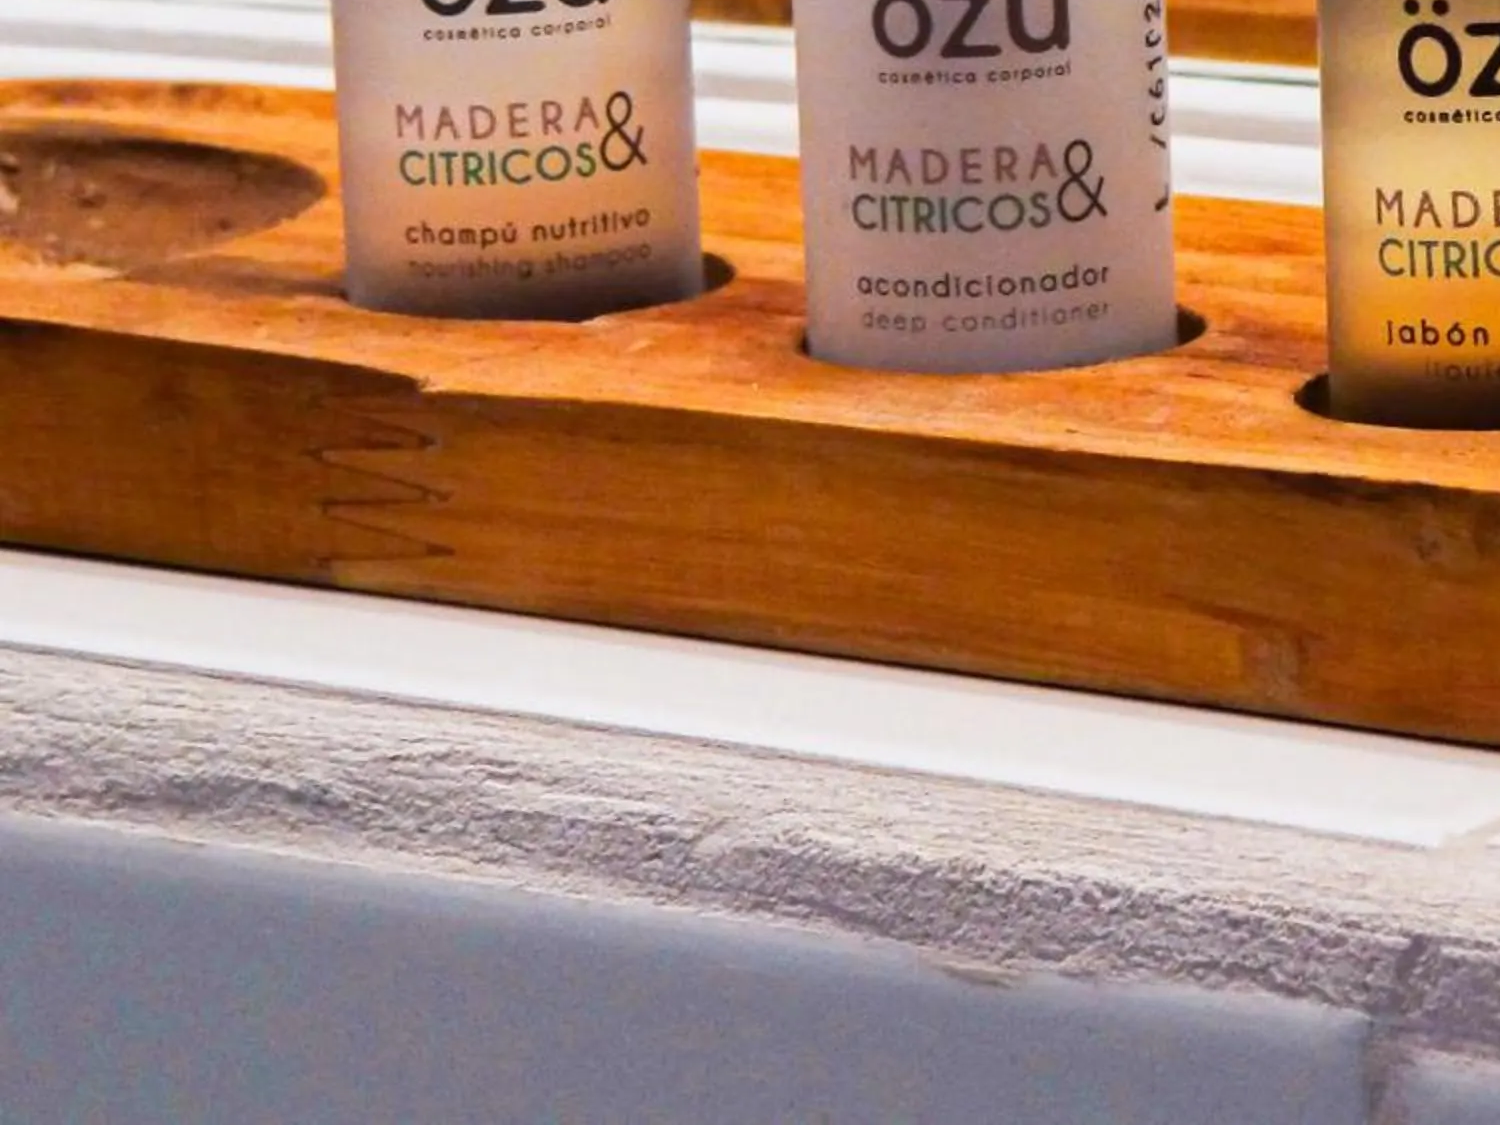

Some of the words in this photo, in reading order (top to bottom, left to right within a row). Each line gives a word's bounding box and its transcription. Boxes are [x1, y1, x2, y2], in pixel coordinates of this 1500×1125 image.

[423, 25, 521, 42] cosmética
[530, 13, 612, 38] corporal
[878, 69, 978, 85] cosmética
[987, 61, 1072, 83] corporal
[395, 96, 600, 142] MADERA
[600, 90, 648, 173] &
[399, 142, 597, 186] CITRICOS
[848, 142, 1058, 185] MADERA
[1057, 138, 1108, 222] &
[405, 219, 518, 250] champú
[532, 206, 651, 243] nutritivo
[851, 191, 1053, 234] CITRICOS
[857, 265, 1110, 300] acondicionador
[861, 306, 927, 334] deep
[941, 302, 1109, 333] conditioner
